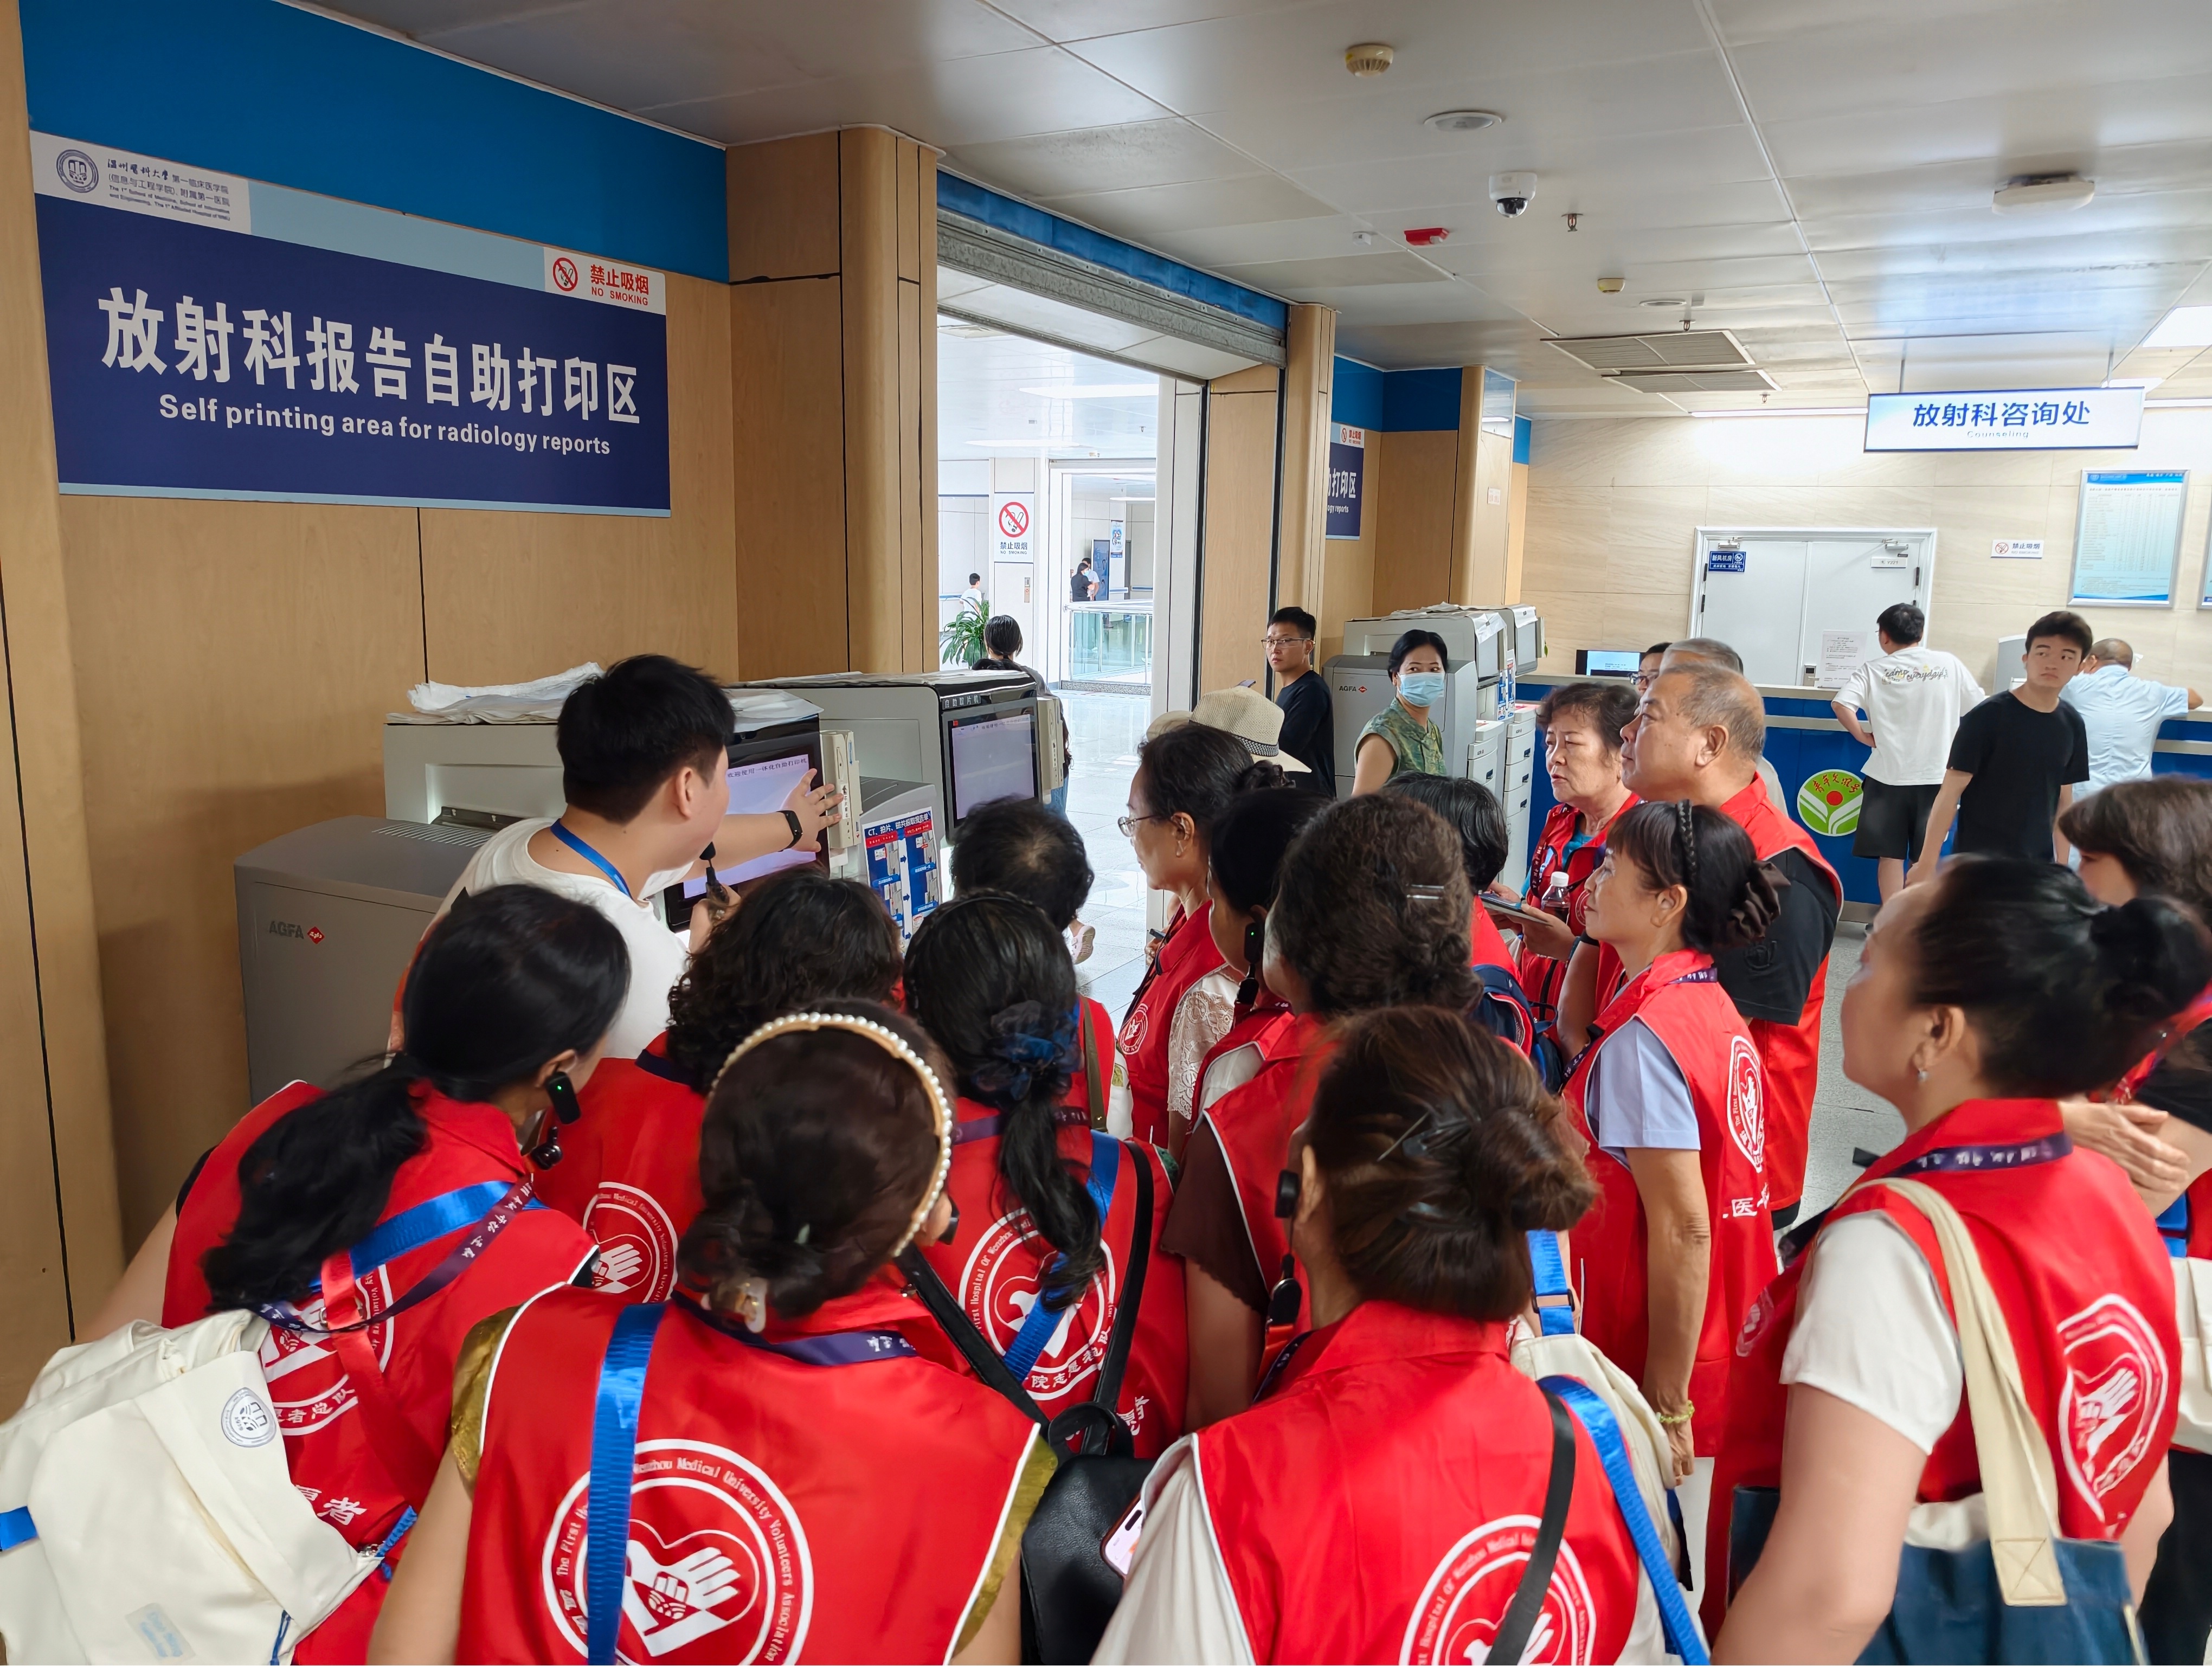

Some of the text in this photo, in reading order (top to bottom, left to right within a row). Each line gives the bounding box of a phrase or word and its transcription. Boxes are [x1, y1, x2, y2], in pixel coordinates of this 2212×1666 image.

[590, 264, 649, 295] 禁止吸烟
[591, 286, 648, 306] NO SMOKING
[98, 287, 640, 424] 放射科报告自助打印区
[159, 394, 610, 455] Self printing area for radiology reports
[1913, 401, 2091, 427] 放射科咨询处
[1335, 505, 1349, 513] reports
[1000, 542, 1027, 550] 禁止吸烟
[728, 758, 808, 777] 欢迎使用一体化自助打印机
[269, 921, 304, 940] AGFA
[560, 1522, 582, 1554] First
[677, 1457, 721, 1478] Medical
[722, 1470, 773, 1520] University
[769, 1519, 793, 1586] Volunteers
